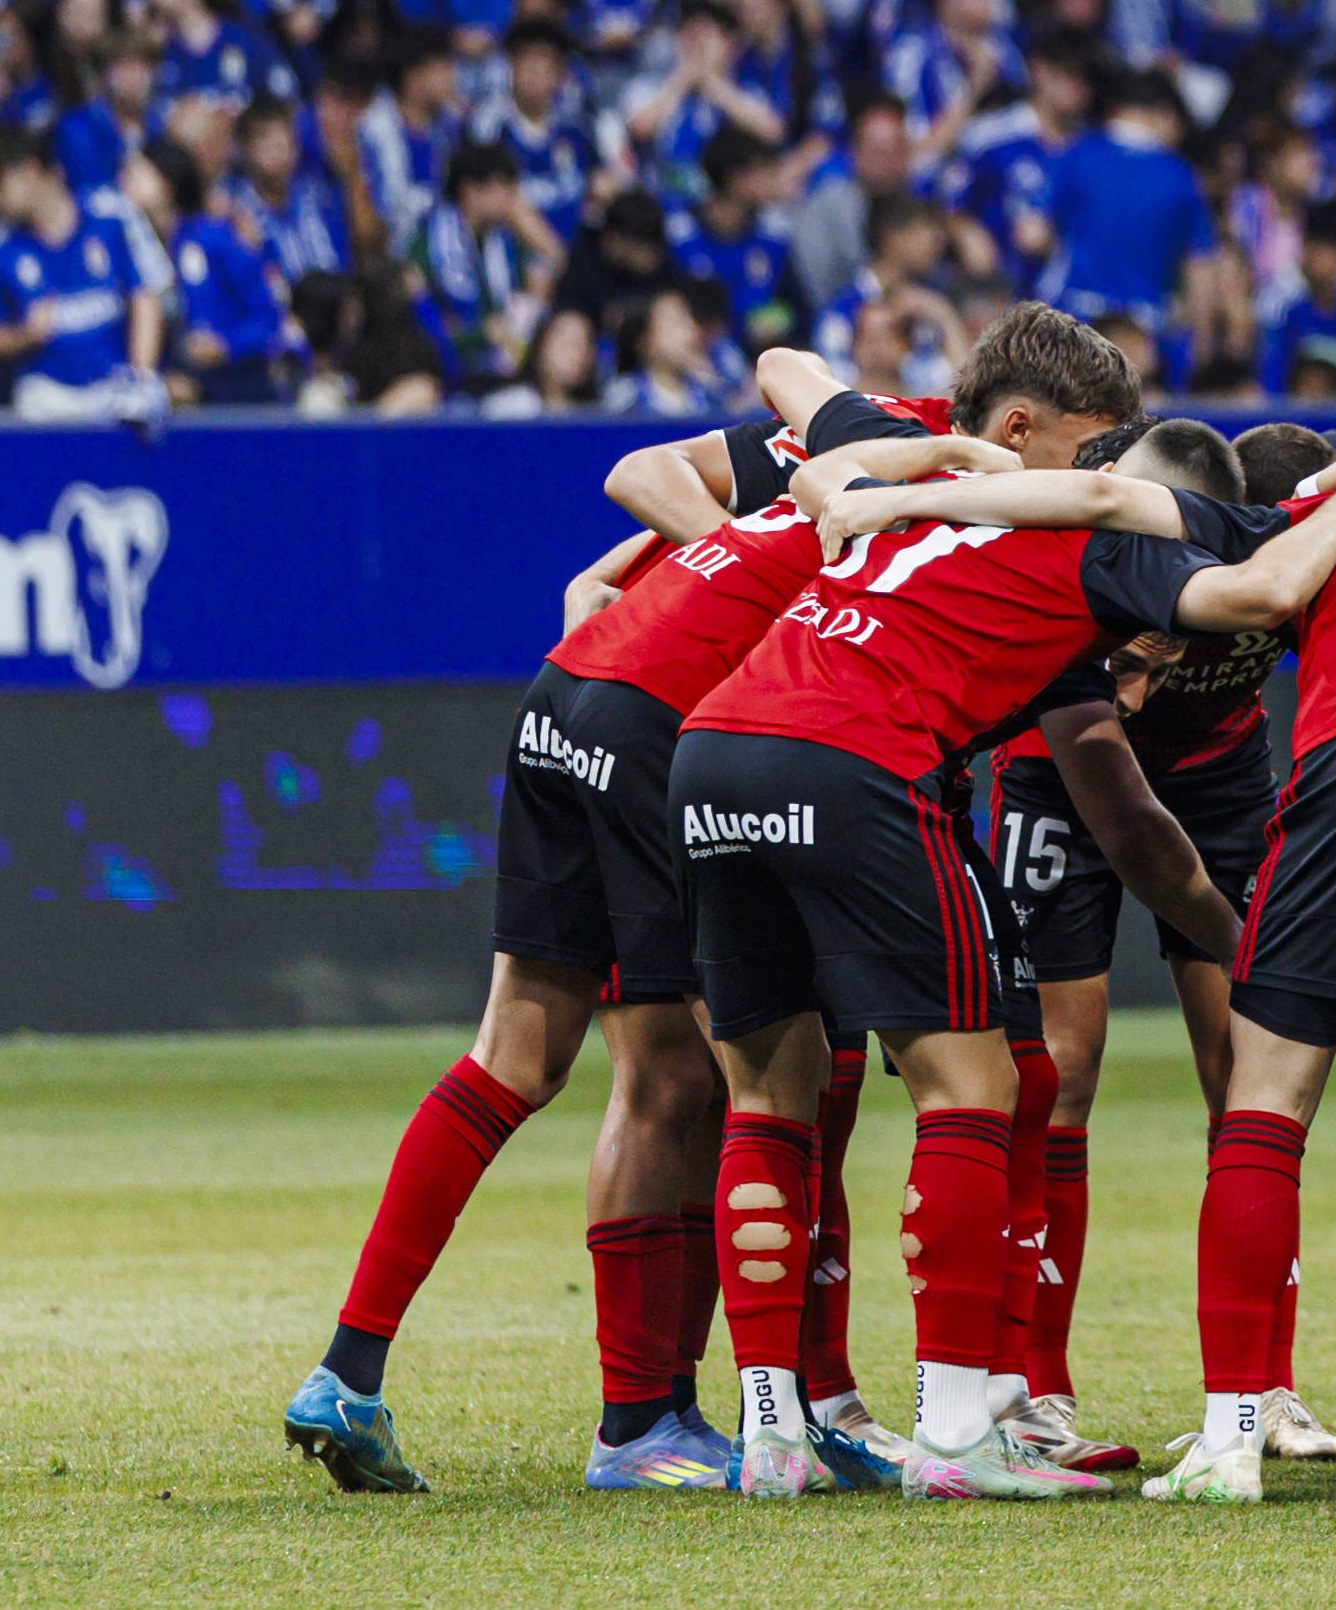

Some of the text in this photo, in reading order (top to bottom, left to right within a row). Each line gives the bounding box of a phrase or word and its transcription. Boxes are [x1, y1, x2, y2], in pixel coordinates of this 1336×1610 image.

[519, 710, 615, 791] Alucoil
[684, 803, 814, 845] Alucoil
[1004, 812, 1072, 892] 15
[752, 1369, 778, 1426] DOGU
[1238, 1404, 1256, 1432] GU
